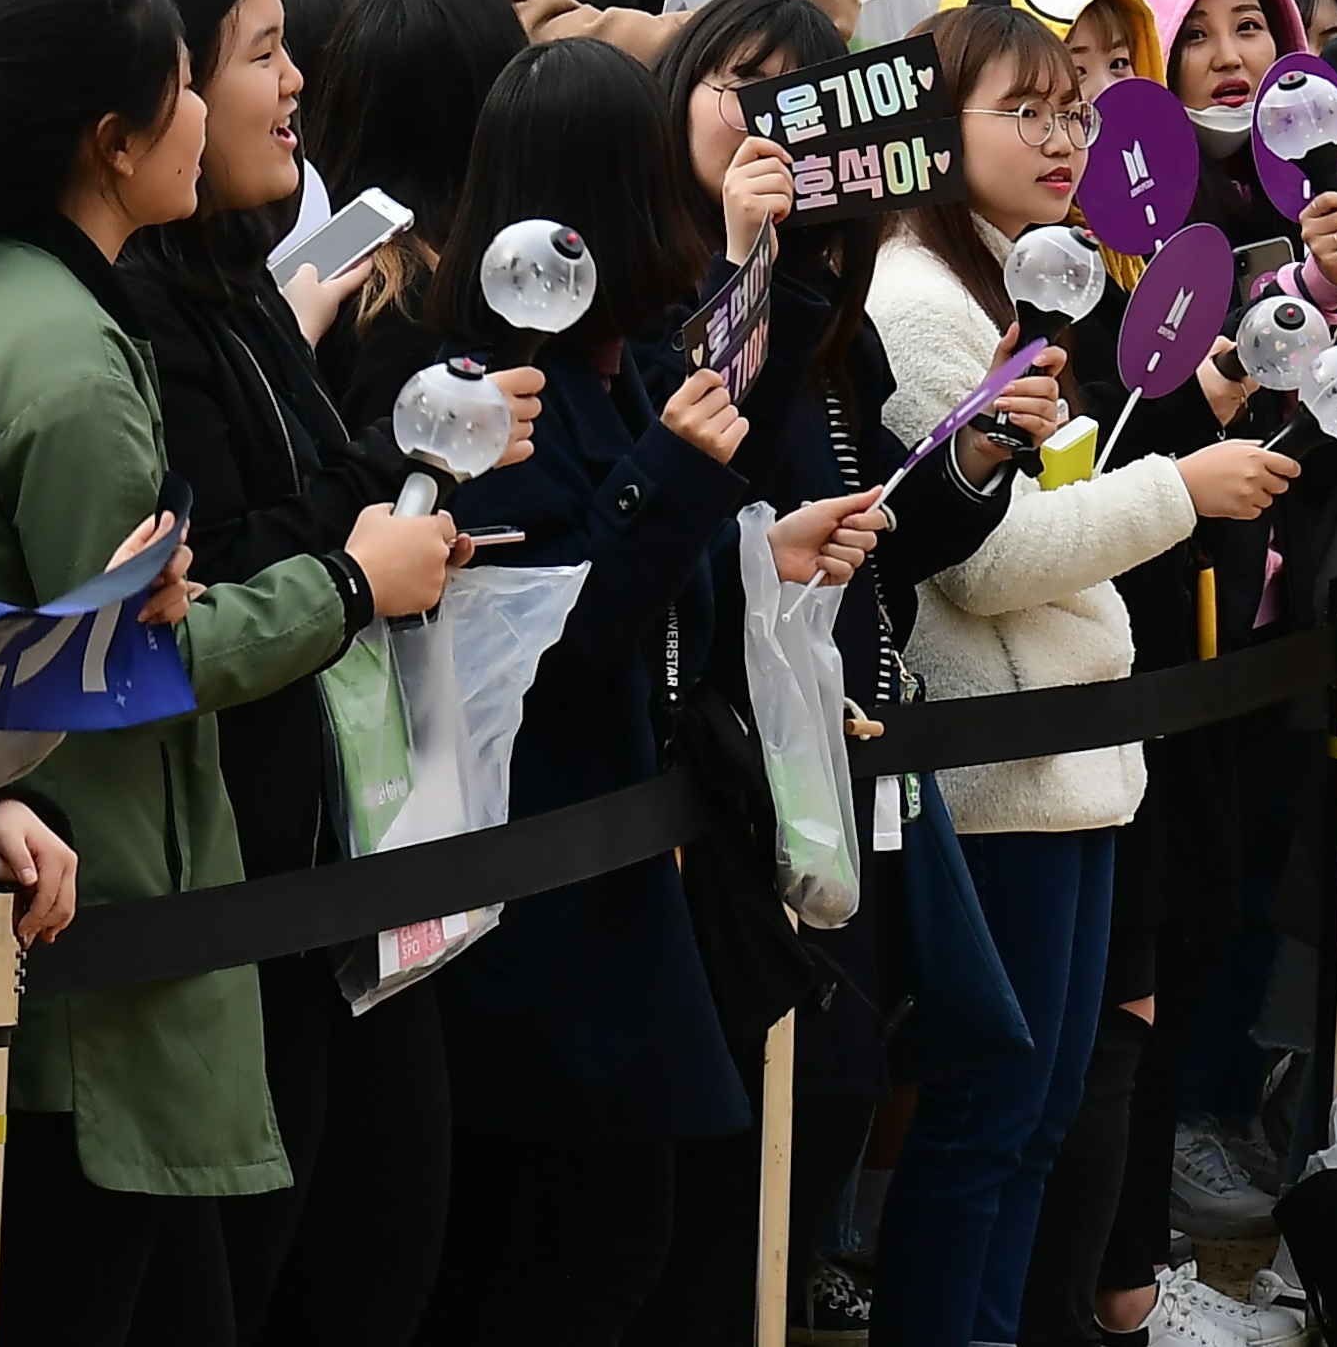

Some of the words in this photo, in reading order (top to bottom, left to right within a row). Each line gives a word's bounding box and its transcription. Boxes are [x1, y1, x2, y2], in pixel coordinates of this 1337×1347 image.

[776, 56, 919, 144] 윤기야
[792, 137, 931, 211] 호석아
[665, 599, 679, 687] NIVERSTAR
